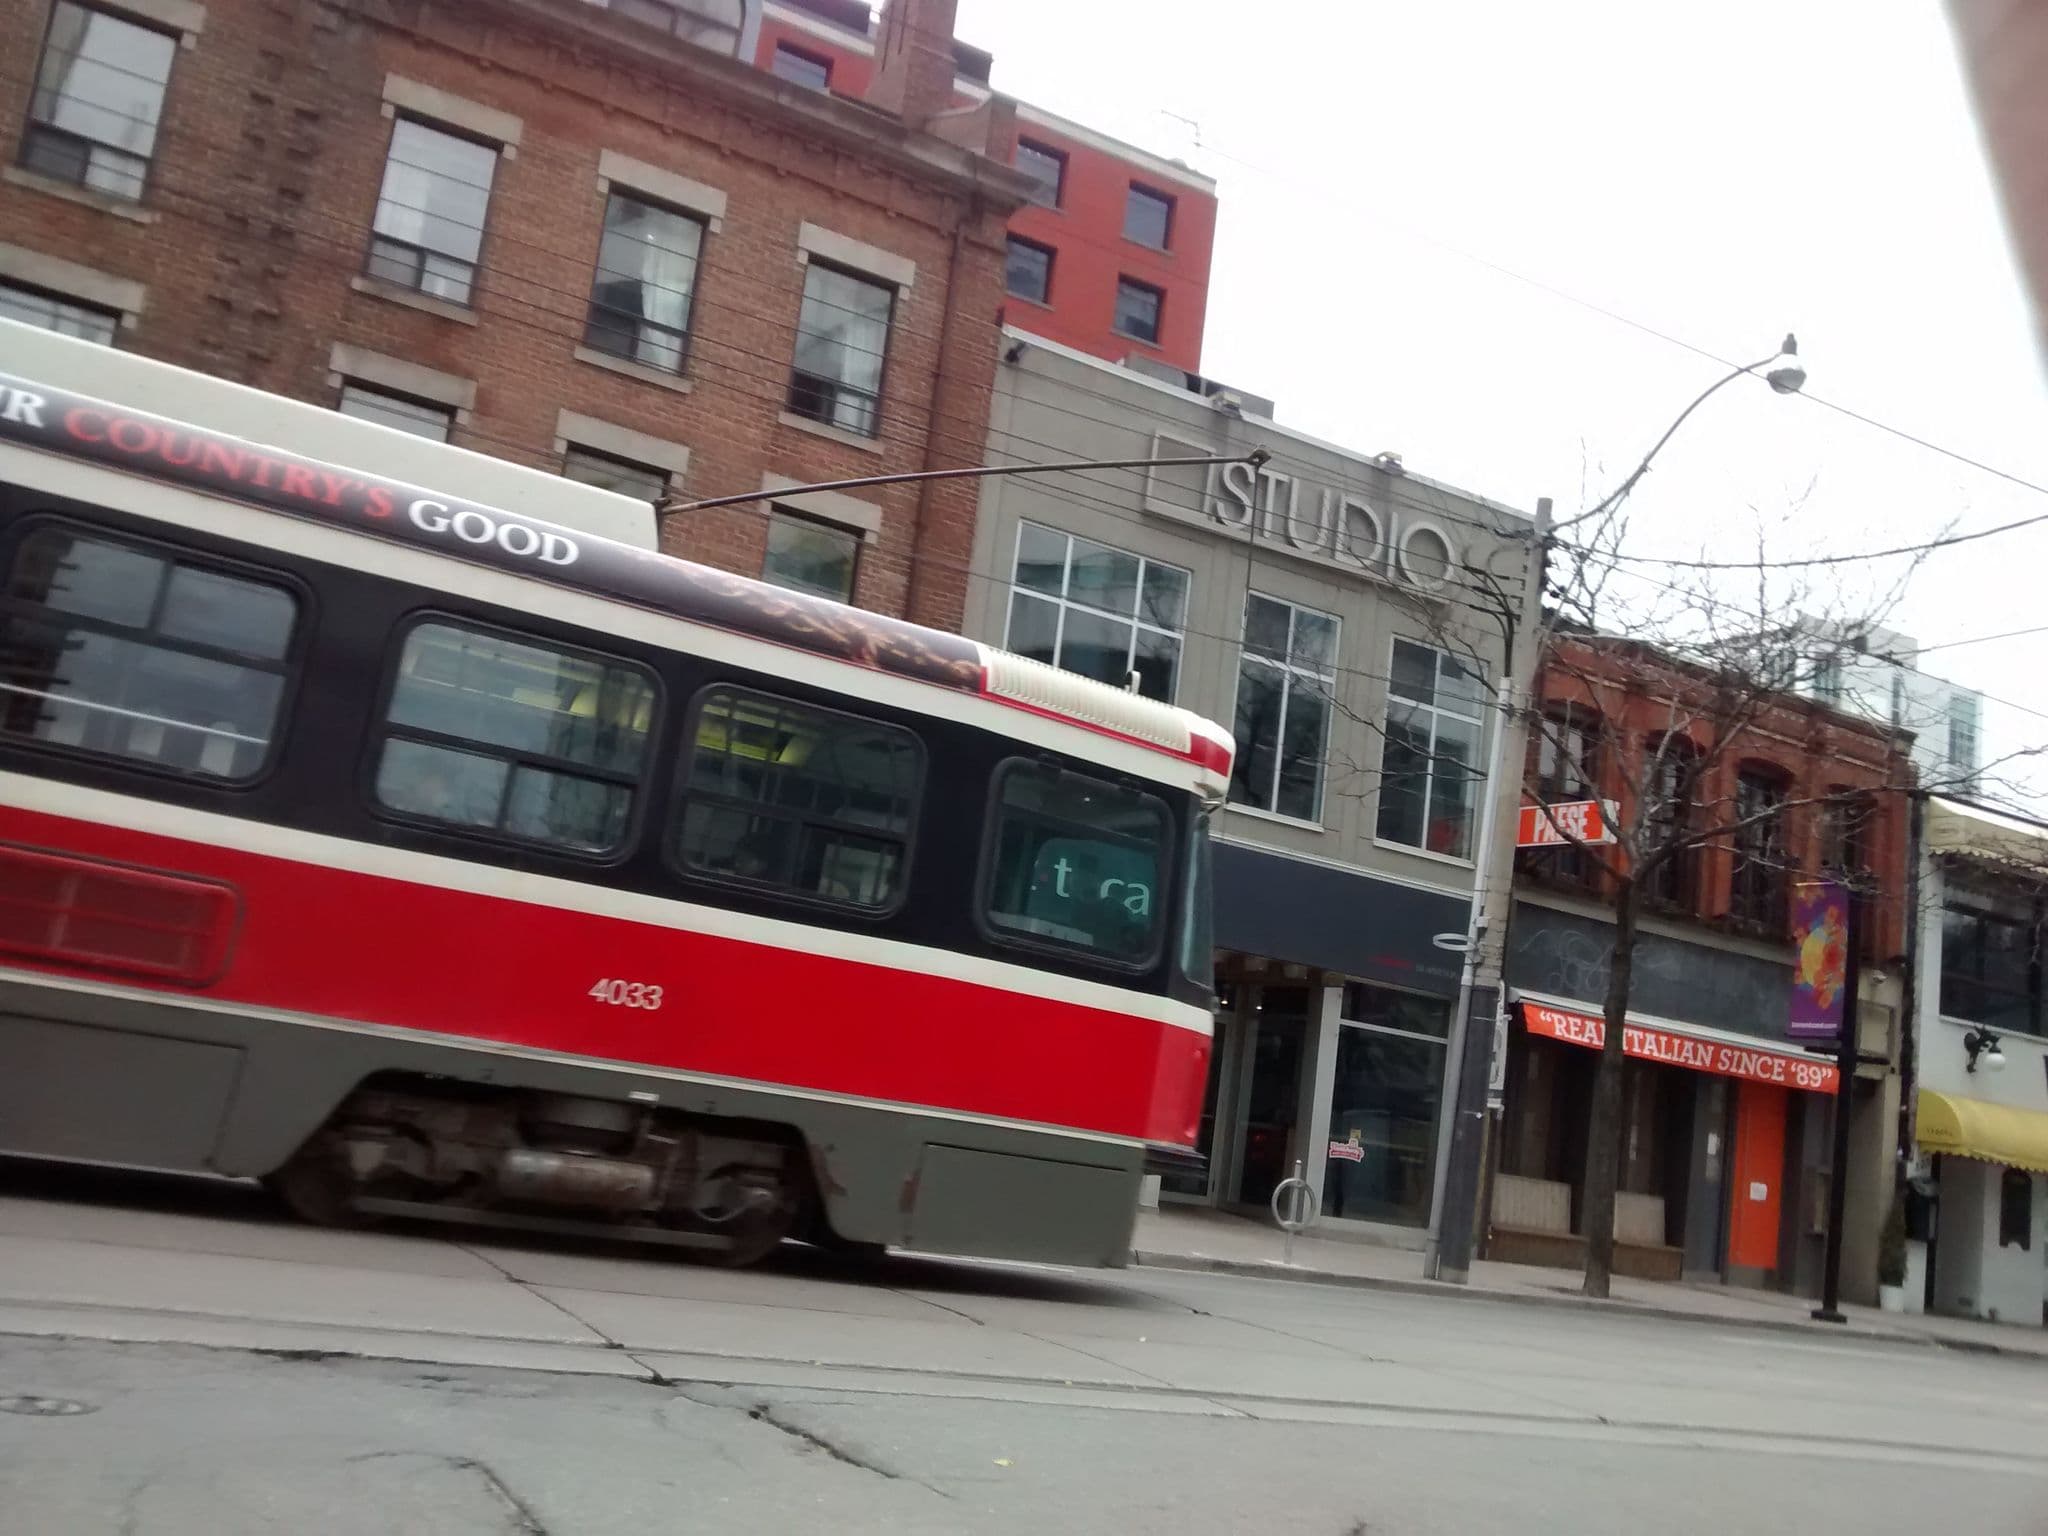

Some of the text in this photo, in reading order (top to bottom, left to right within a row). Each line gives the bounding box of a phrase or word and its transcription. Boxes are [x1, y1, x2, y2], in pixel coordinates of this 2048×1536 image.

[0, 385, 580, 566] R COUNTRY'S GOOD
[1213, 460, 1456, 591] STUDIO
[587, 978, 664, 1010] 4033
[1717, 1048, 1786, 1081] SINCE
